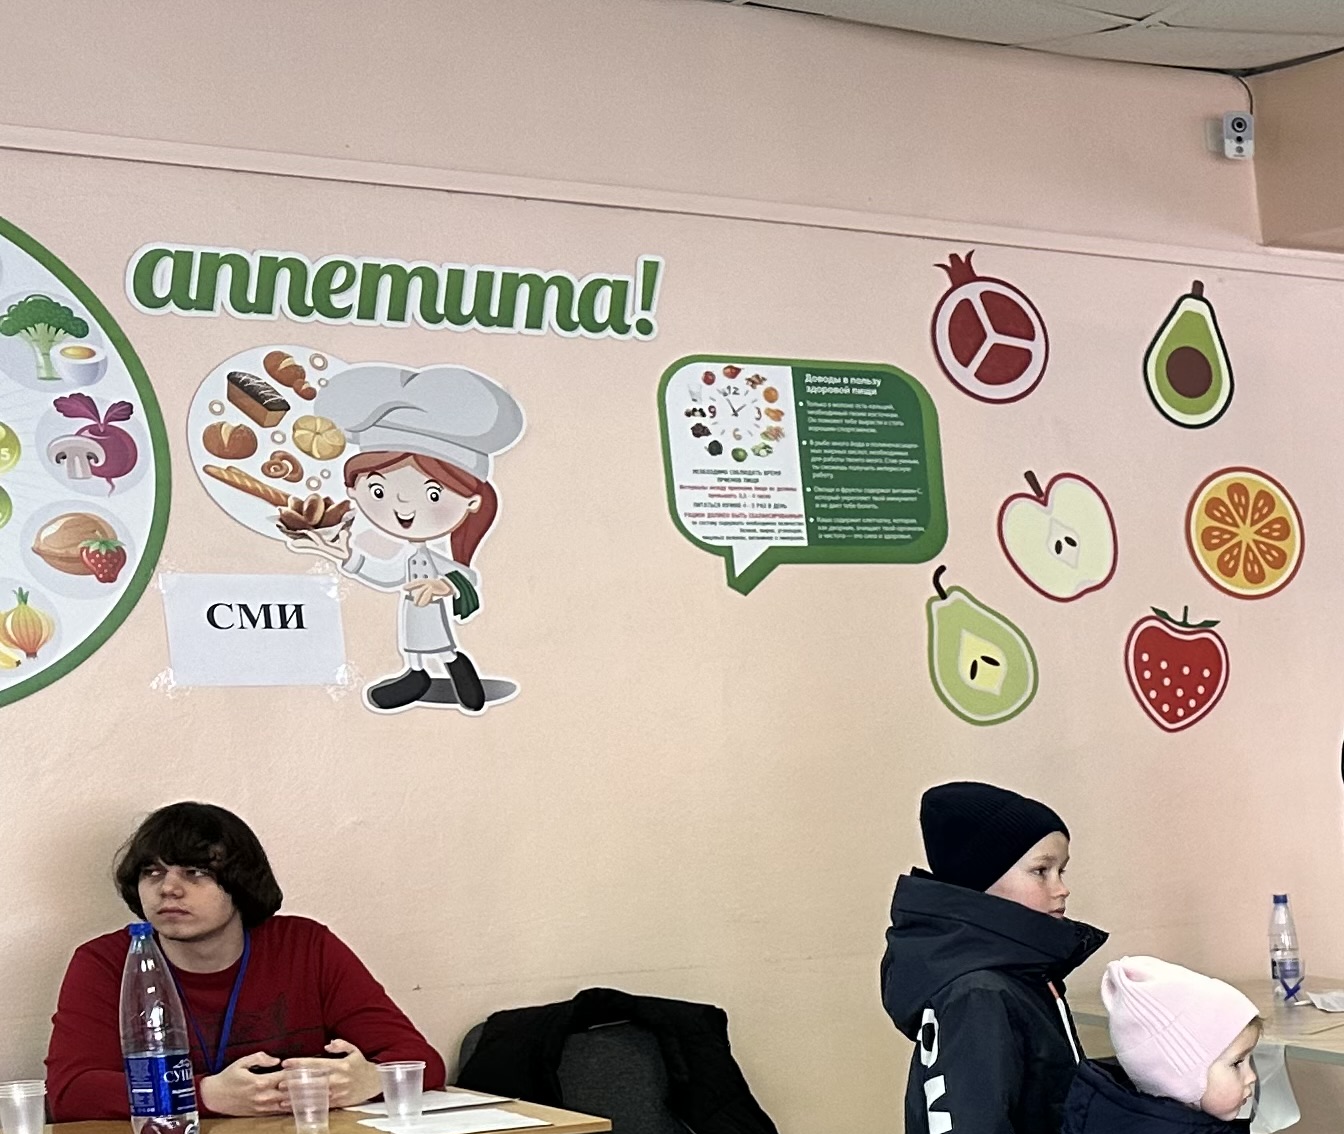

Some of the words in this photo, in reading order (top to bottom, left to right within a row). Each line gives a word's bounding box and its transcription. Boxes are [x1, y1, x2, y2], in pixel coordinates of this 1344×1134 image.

[708, 405, 716, 418] 9
[733, 428, 742, 440] 6
[206, 602, 307, 630] СМИ
